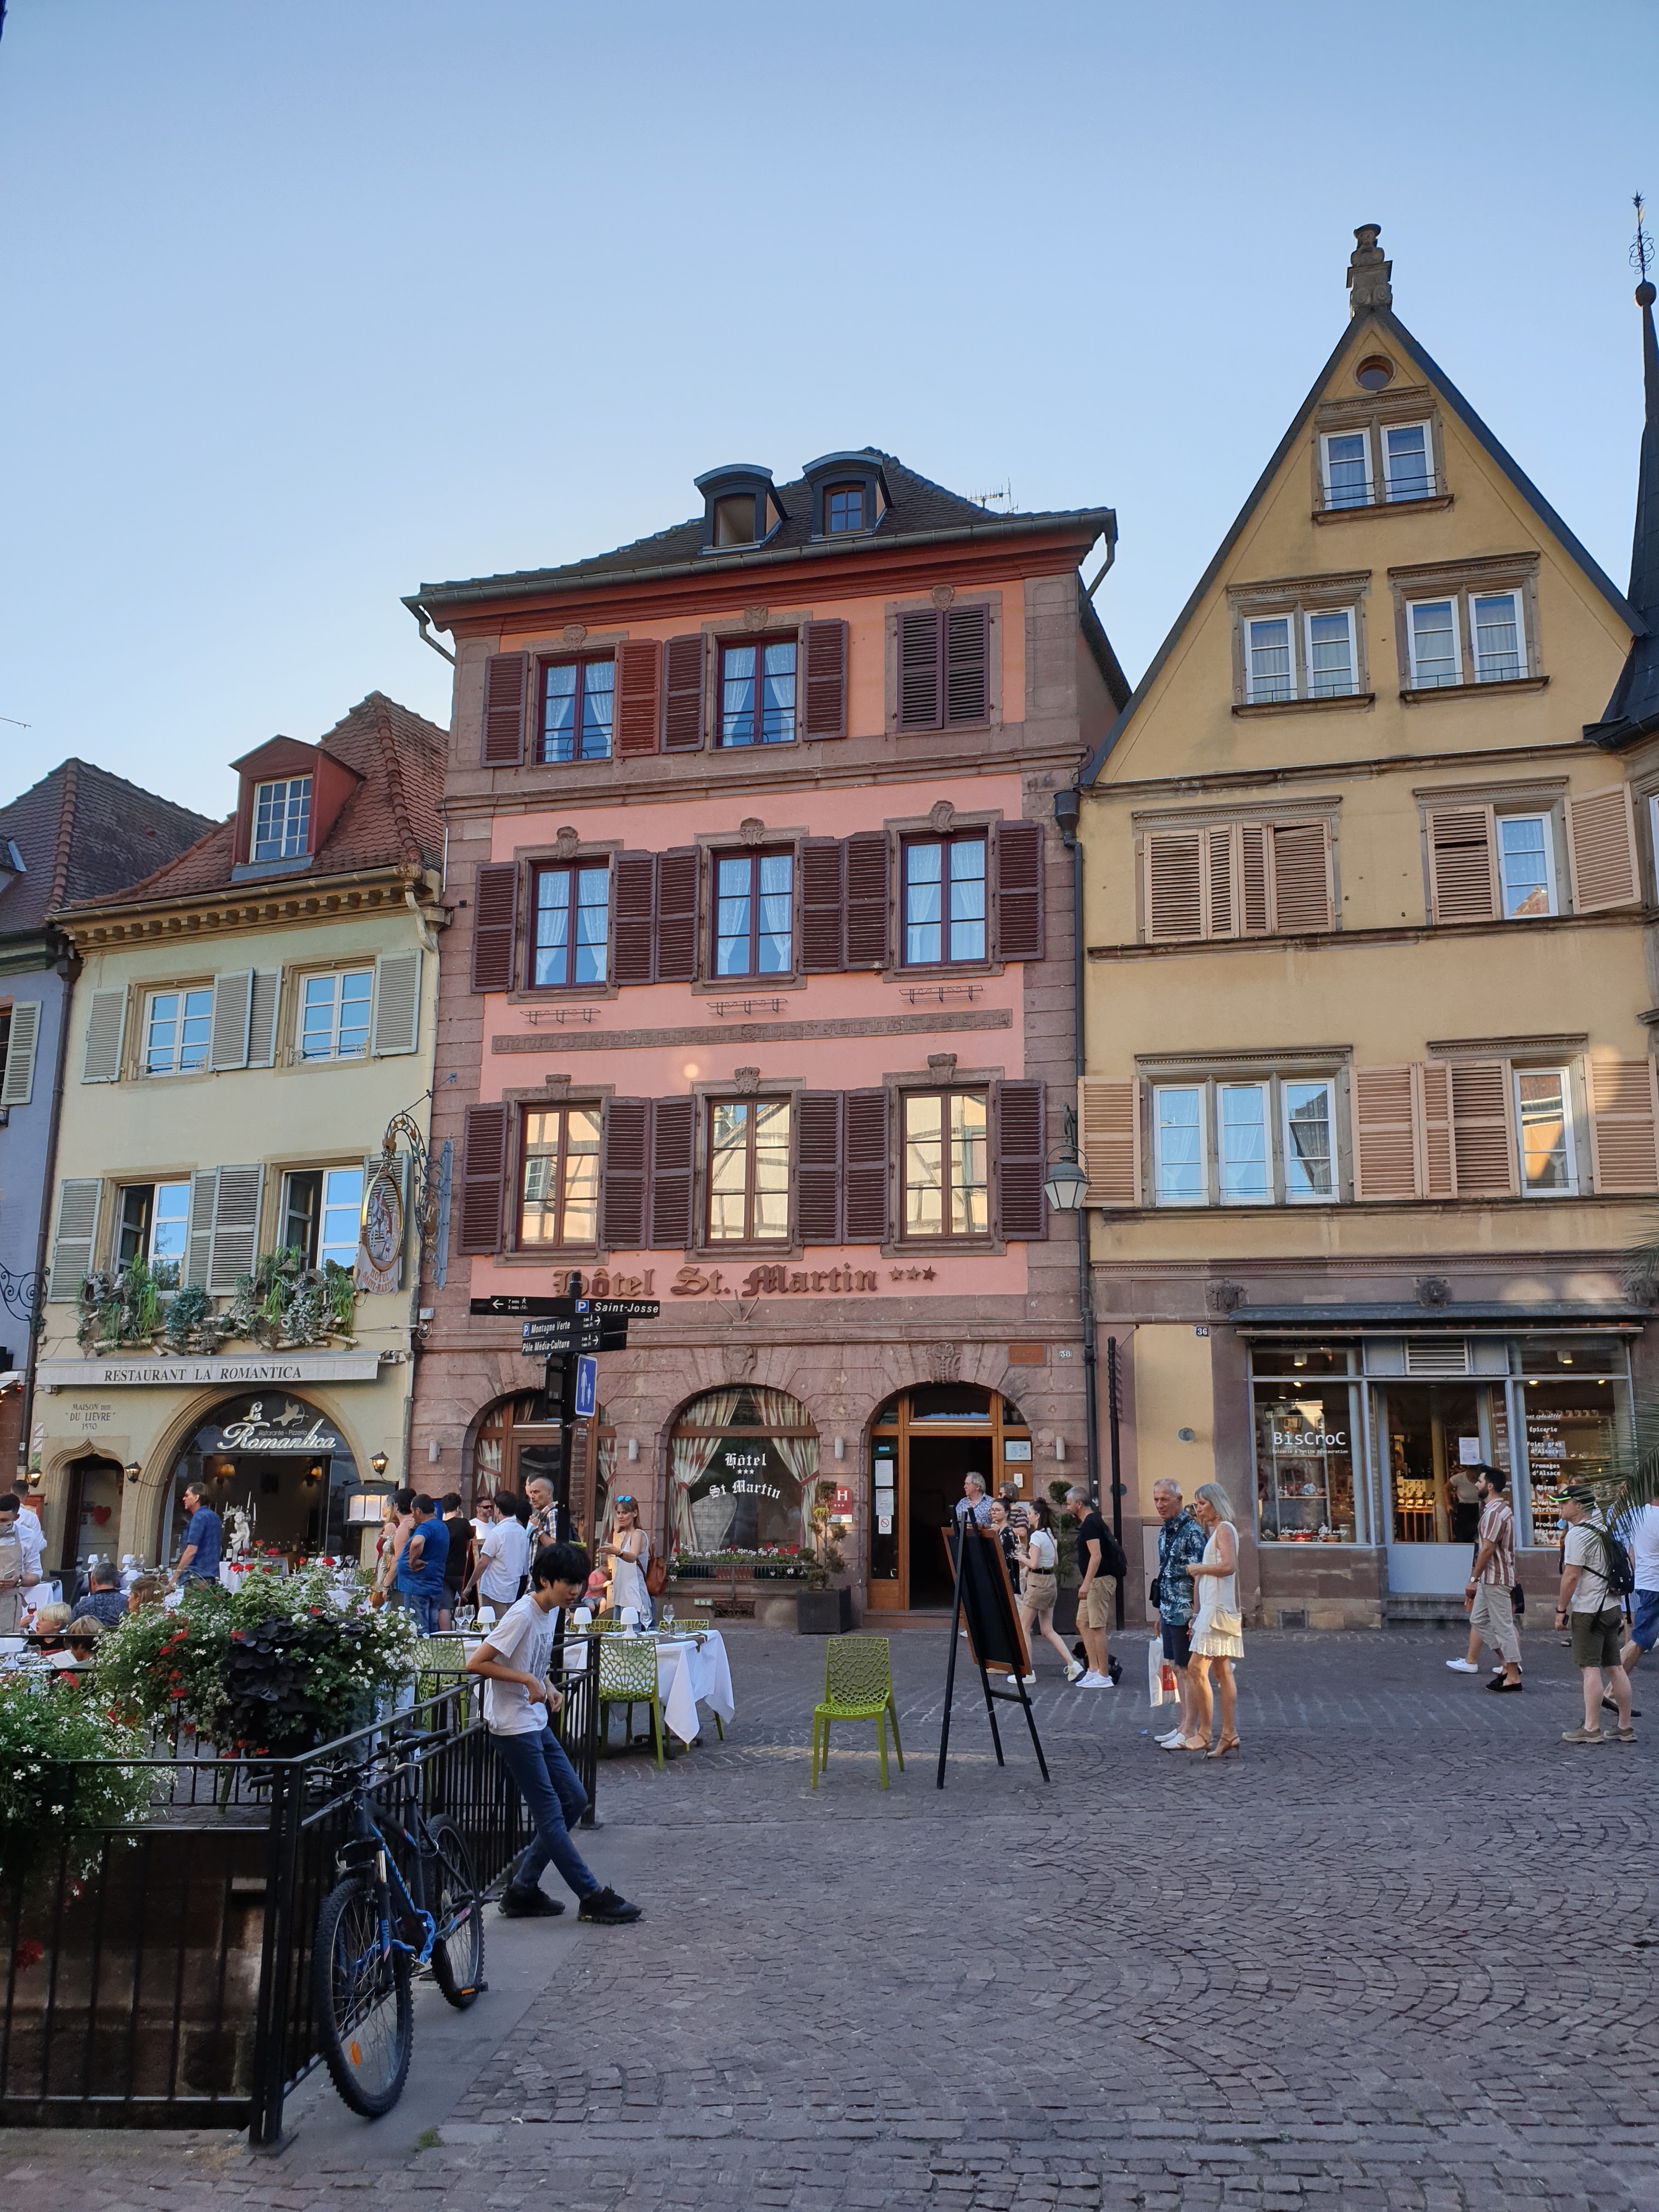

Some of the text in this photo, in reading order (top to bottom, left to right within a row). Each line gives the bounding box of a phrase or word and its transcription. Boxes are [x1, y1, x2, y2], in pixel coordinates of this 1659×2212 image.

[370, 1268, 390, 1282] HOTEL
[670, 1266, 730, 1295] St.
[741, 1262, 878, 1296] Martin
[594, 1302, 659, 1313] Saint-Josse
[531, 1324, 555, 1334] Montagne
[557, 1321, 571, 1330] Verte
[522, 1339, 570, 1352] Pôle Média-Culture
[104, 1367, 301, 1381] RESTAURANT LA ROMANTICA
[242, 1401, 263, 1421] La
[217, 1418, 336, 1449] Romantica
[1273, 1431, 1346, 1445] BisCroC
[725, 1453, 767, 1469] Hôtel
[709, 1480, 781, 1499] St Martin
[837, 1490, 848, 1501] H
[381, 1919, 390, 1938] MTB
